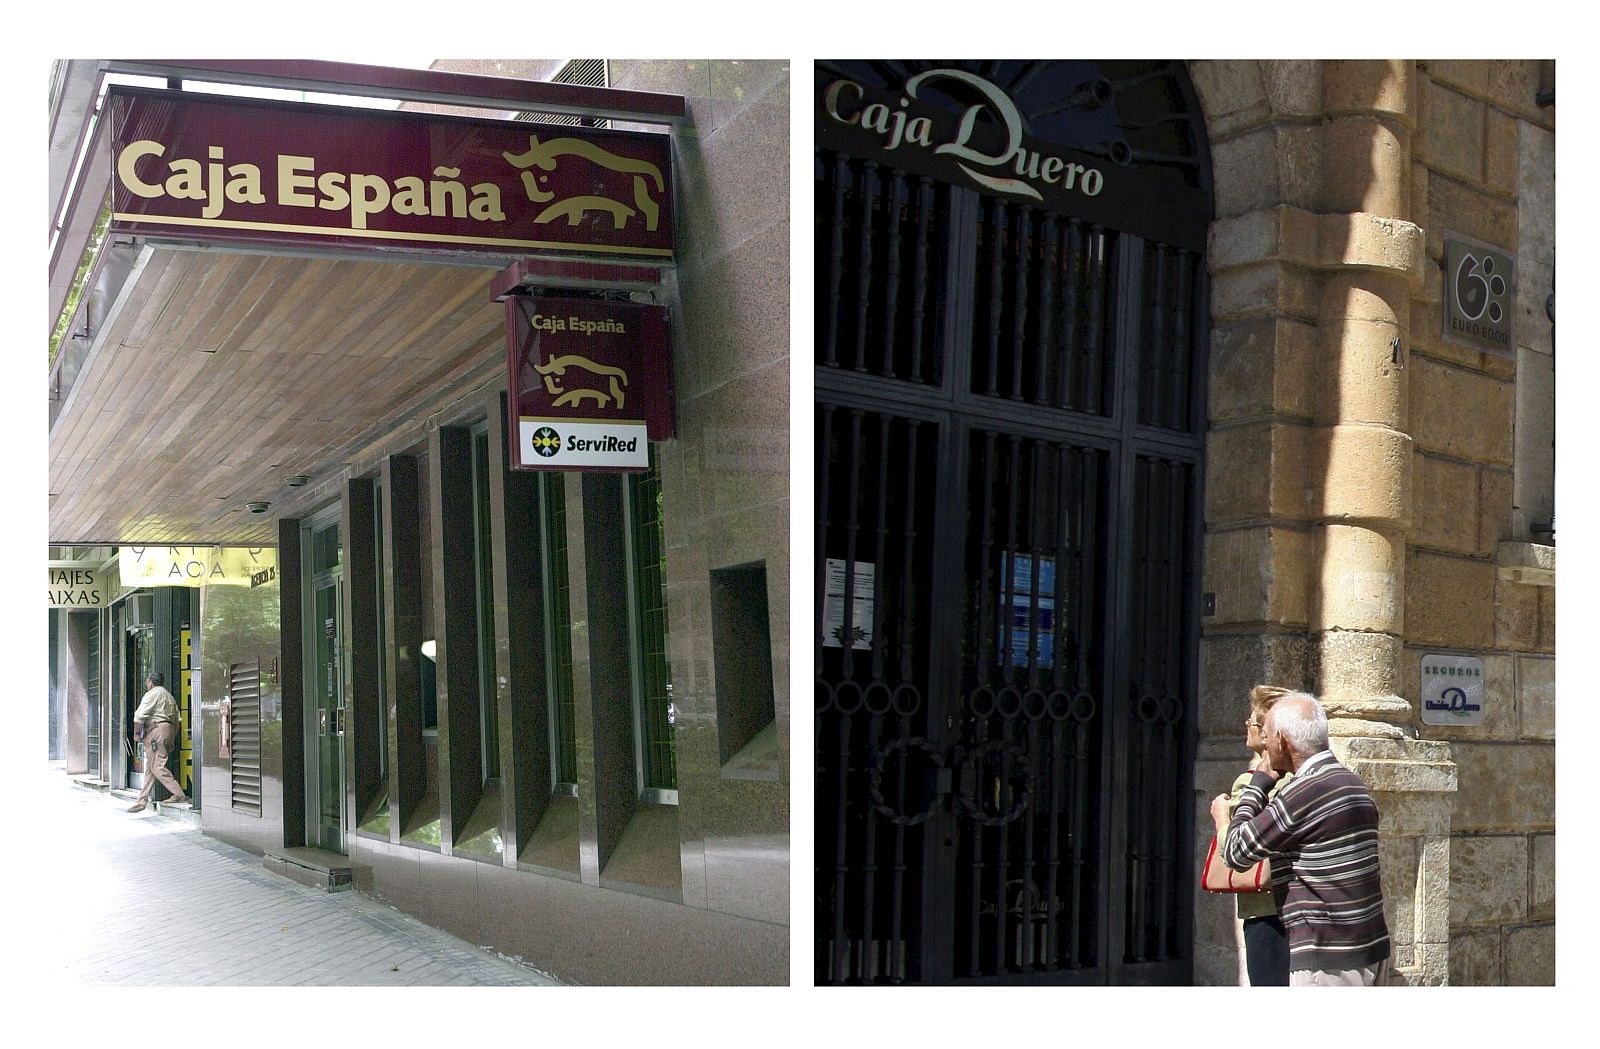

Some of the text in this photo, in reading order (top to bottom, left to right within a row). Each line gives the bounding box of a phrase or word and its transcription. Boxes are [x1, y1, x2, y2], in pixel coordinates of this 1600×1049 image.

[824, 68, 1104, 201] Caja Duero
[117, 139, 506, 229] Caja España
[531, 314, 625, 335] Caja España
[1452, 318, 1508, 344] EURO 6000
[567, 435, 637, 453] ServiRed
[1424, 666, 1480, 676] SEGUROS
